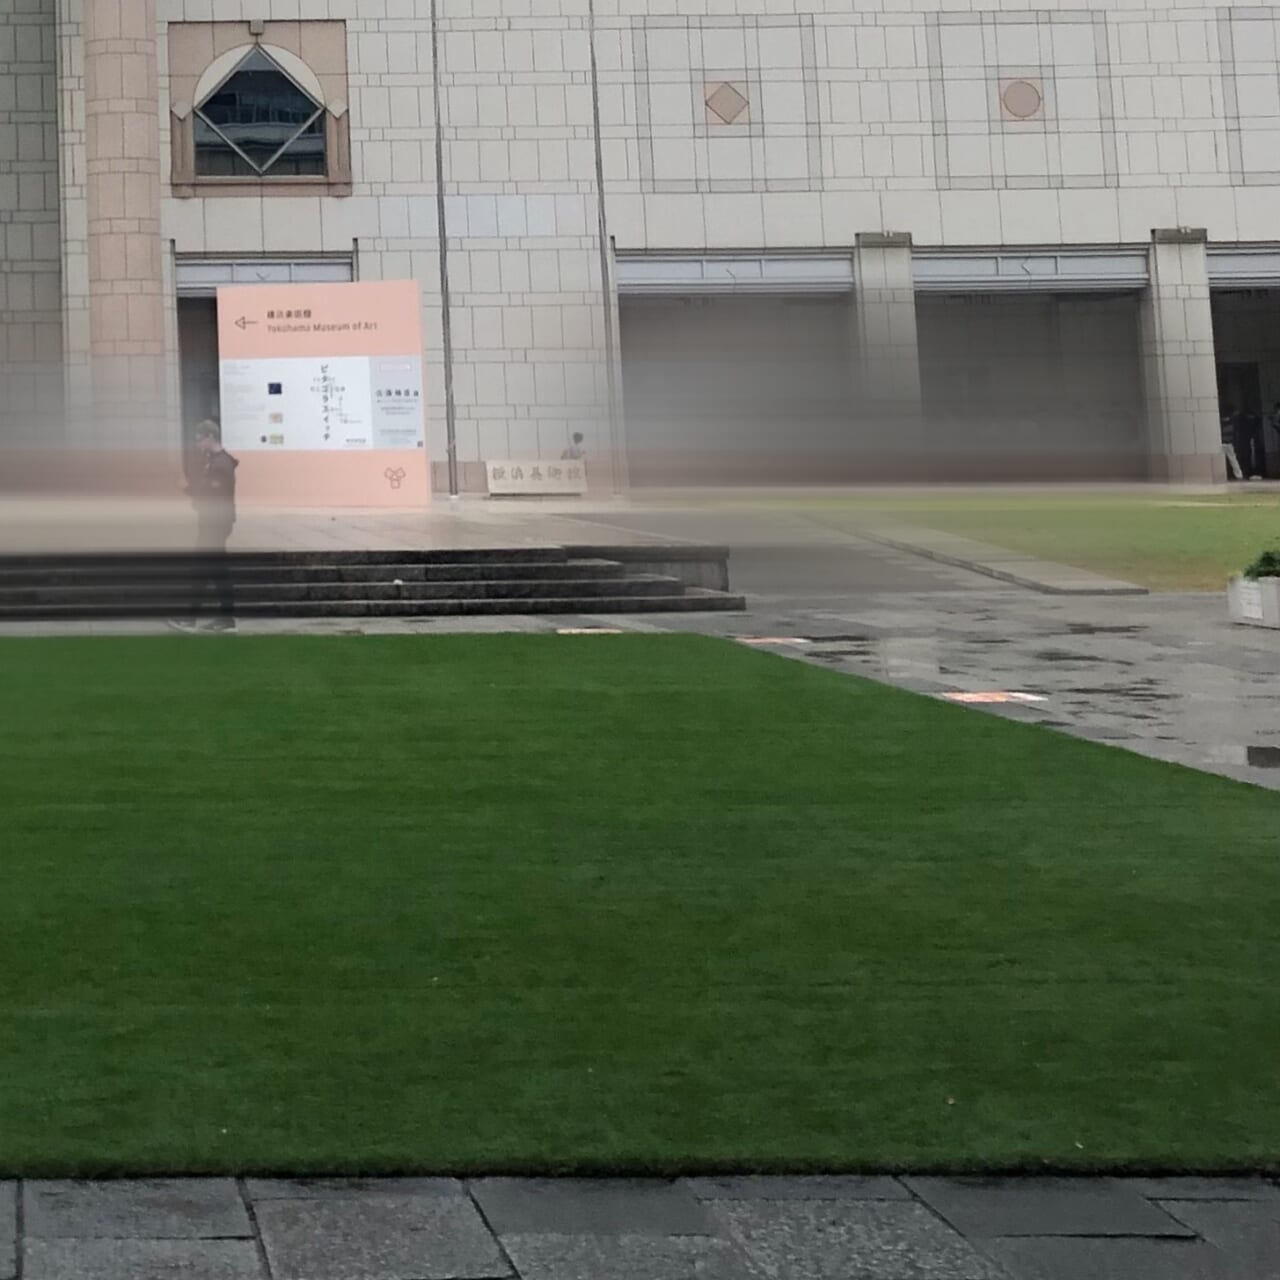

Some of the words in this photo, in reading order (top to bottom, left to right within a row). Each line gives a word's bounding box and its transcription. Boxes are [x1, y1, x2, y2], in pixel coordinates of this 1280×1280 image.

[313, 322, 350, 332] Museum
[352, 322, 362, 331] of
[363, 321, 378, 331] Art
